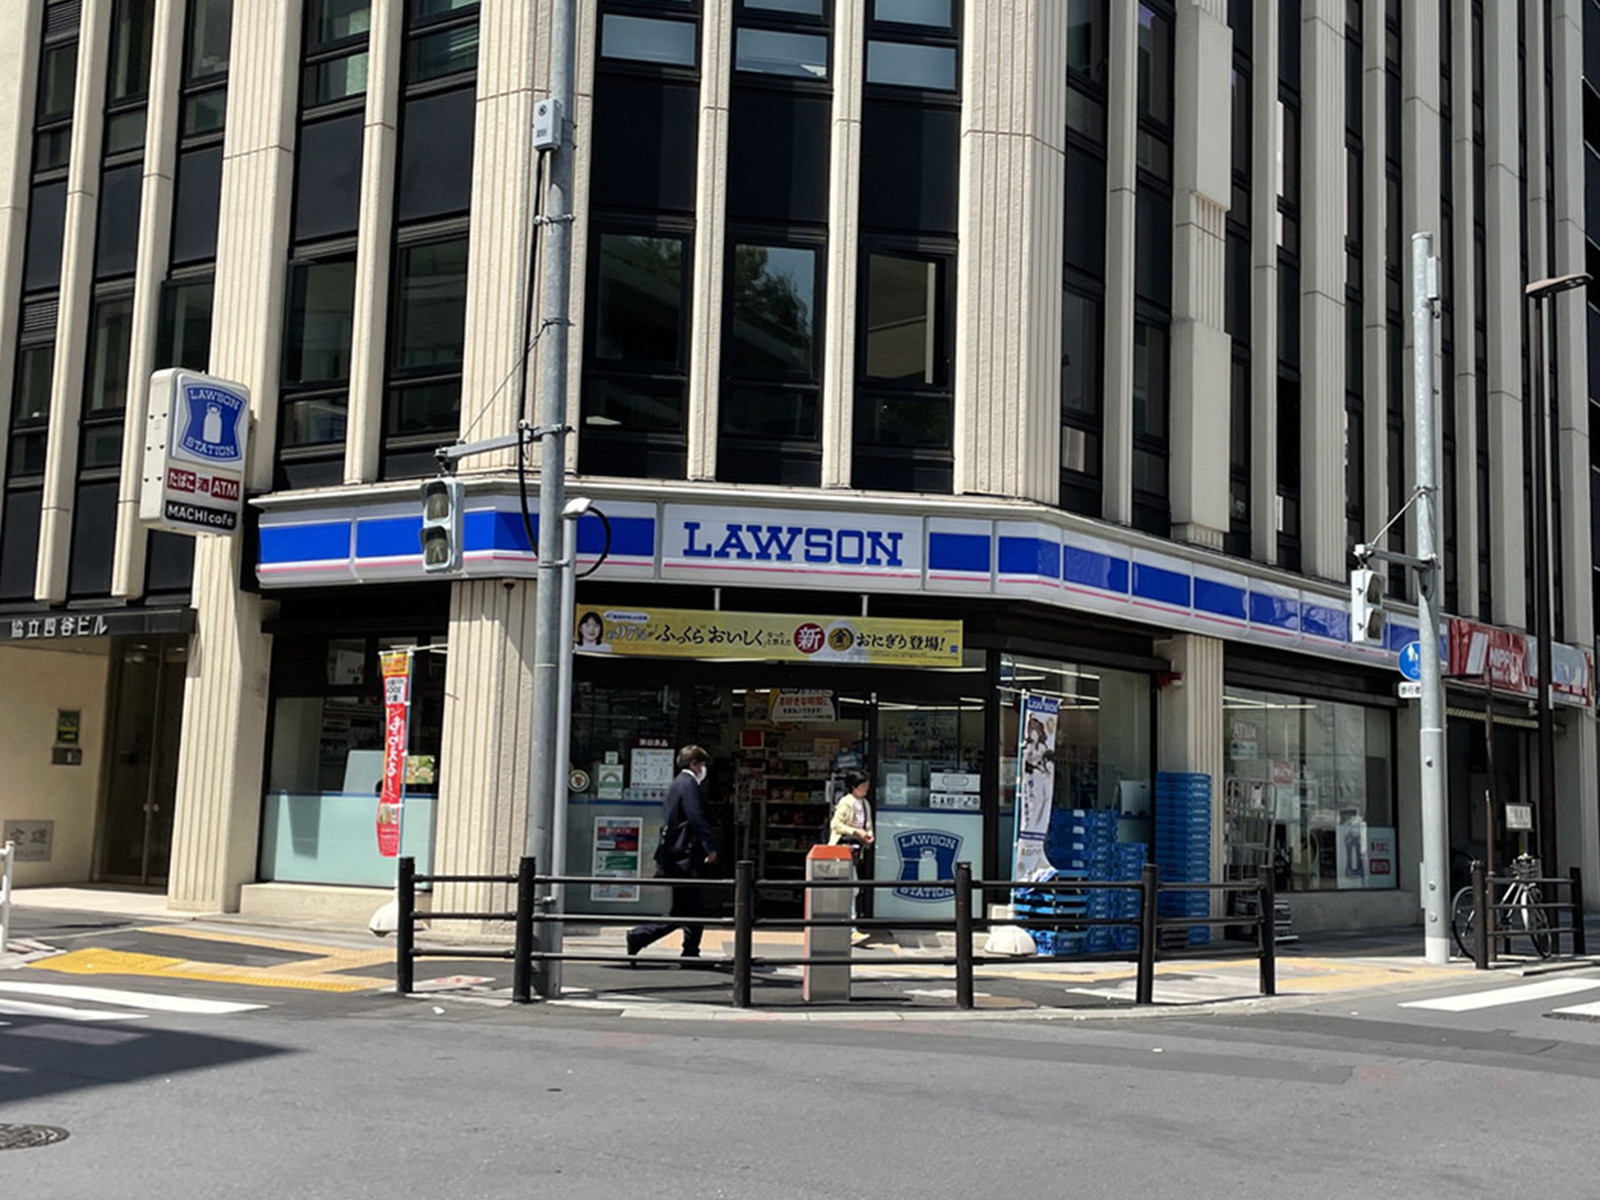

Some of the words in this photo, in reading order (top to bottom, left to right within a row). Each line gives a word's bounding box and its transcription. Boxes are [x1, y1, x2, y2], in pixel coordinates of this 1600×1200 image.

[190, 390, 240, 410] LAWSON
[186, 437, 235, 456] STATION
[170, 472, 195, 490] たばこ
[212, 480, 238, 498] ATM
[683, 522, 903, 566] LAWSON
[798, 627, 822, 650] 新
[900, 835, 956, 849] LAWSON
